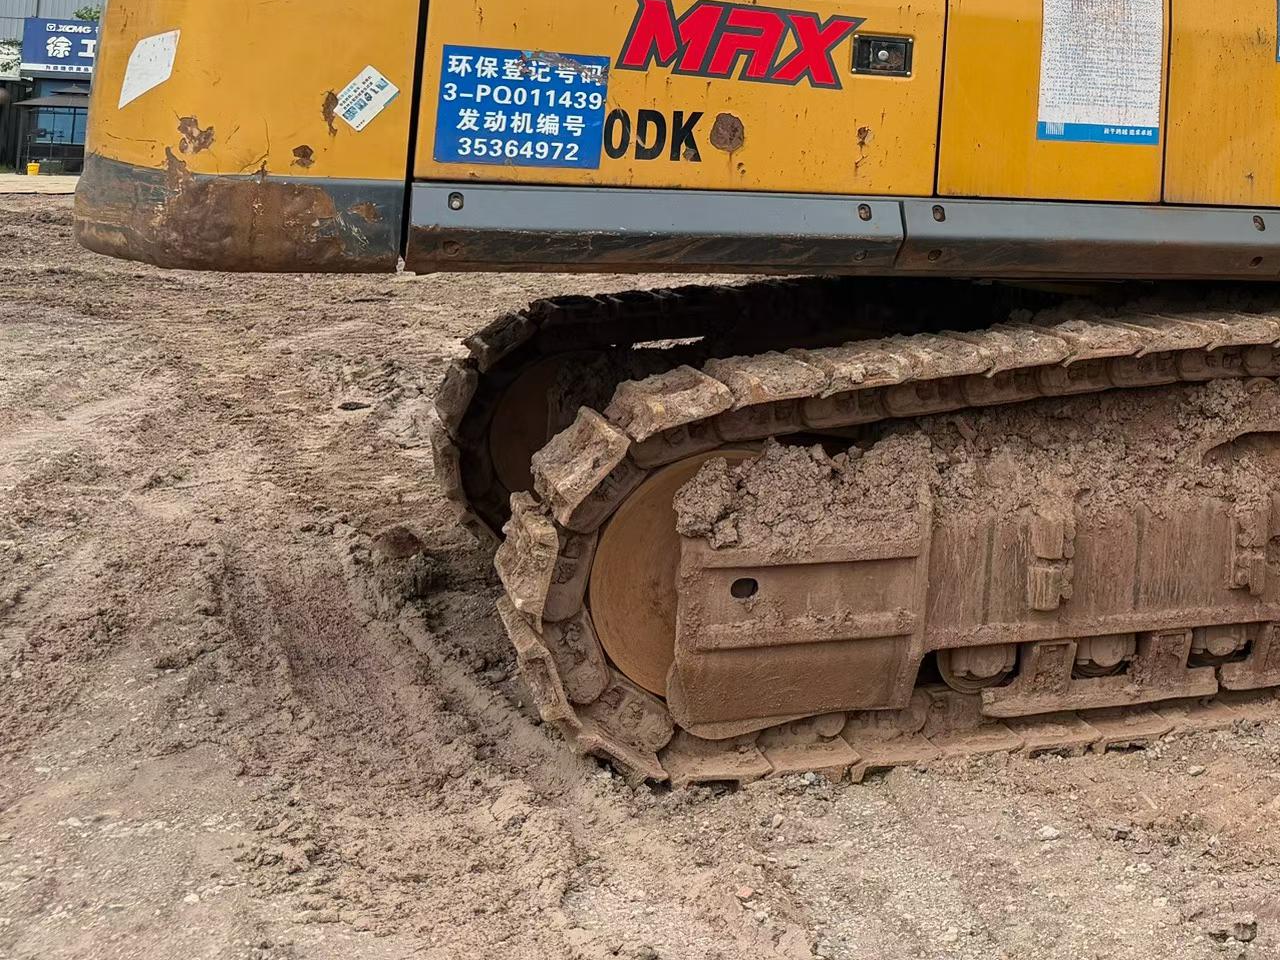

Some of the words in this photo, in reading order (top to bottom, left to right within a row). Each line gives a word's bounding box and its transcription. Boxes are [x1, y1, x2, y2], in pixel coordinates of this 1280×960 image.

[56, 24, 92, 34] XCMG
[442, 82, 603, 111] 3-PQ011439
[455, 108, 587, 137] 发动机编号
[457, 137, 580, 162] 35364972
